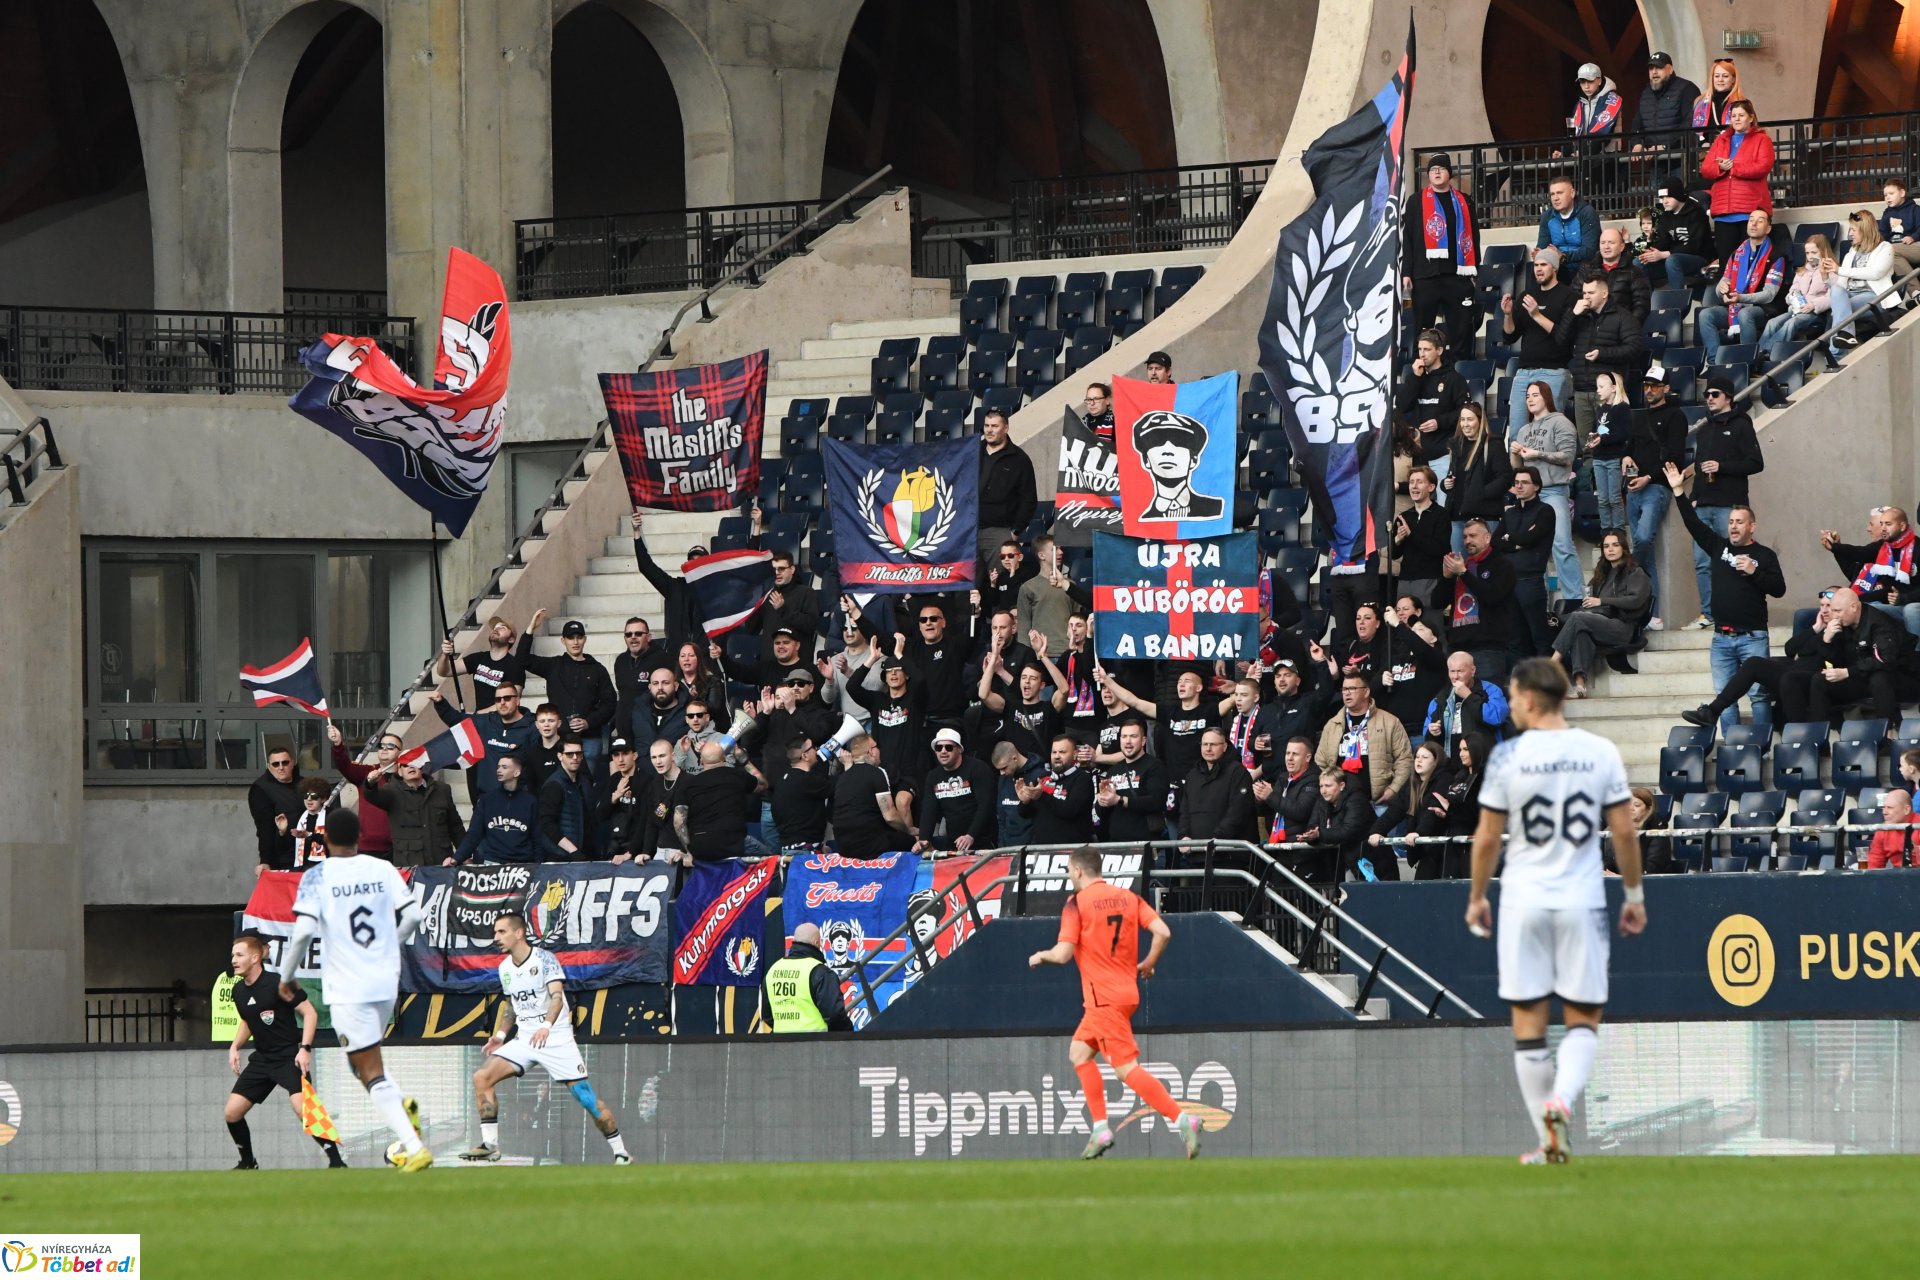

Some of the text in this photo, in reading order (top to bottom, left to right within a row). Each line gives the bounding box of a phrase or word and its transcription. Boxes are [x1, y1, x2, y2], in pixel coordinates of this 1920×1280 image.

[672, 388, 706, 424] the
[644, 417, 742, 459] Mastiffs
[660, 458, 736, 494] Family
[1137, 538, 1221, 568] ÚJRA
[864, 565, 923, 583] Mastiffs
[1113, 579, 1243, 614] DÜBÖRÖG
[1116, 633, 1242, 658] A BANDA!
[488, 815, 527, 833] ellesse
[1522, 790, 1594, 848] 66
[331, 881, 385, 898] DUARTE
[458, 866, 531, 892] mastiffs
[806, 881, 882, 908] Guests
[350, 905, 376, 949] 6
[1107, 914, 1123, 957] 7
[1799, 930, 1920, 980] PUSK
[773, 981, 797, 997] 1260
